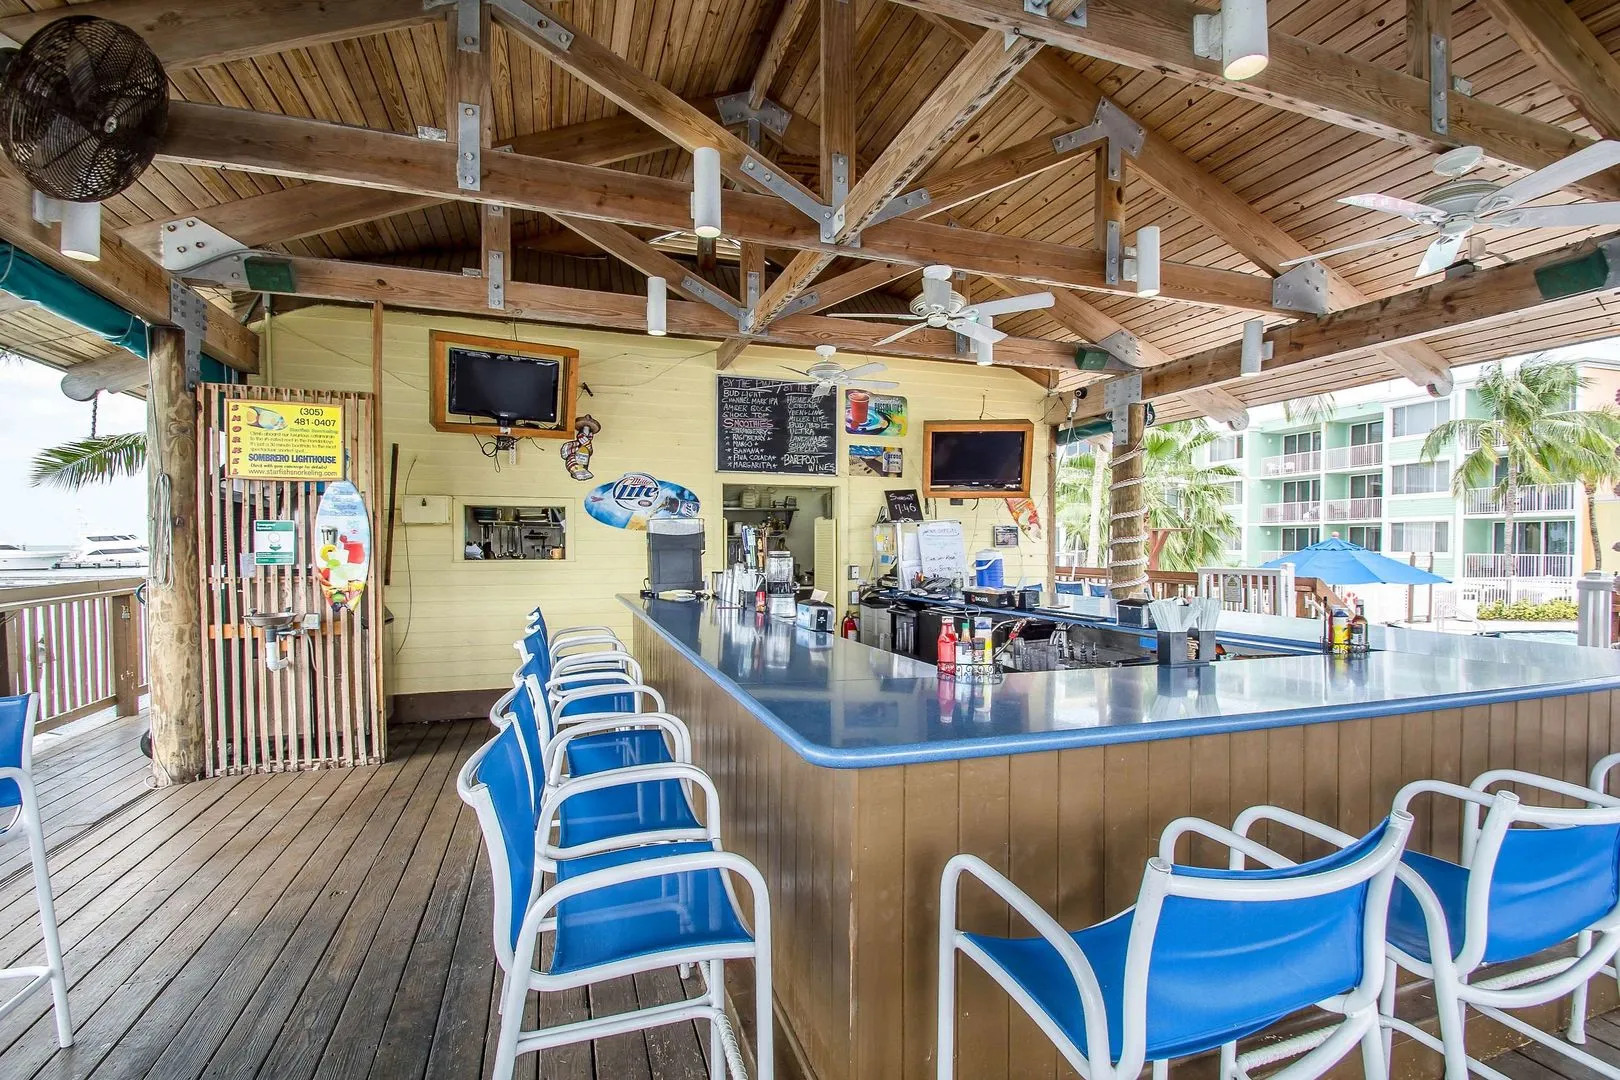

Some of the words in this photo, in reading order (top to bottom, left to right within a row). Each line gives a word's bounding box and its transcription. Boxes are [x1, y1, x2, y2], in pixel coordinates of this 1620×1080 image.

[722, 378, 734, 387] BY
[723, 389, 739, 397] BUD
[300, 408, 323, 416] (305)
[724, 403, 748, 412] AMBER
[294, 418, 336, 426] 481-0407
[723, 418, 773, 428] SMOOTHIES
[249, 454, 289, 462] SOMBRERO
[292, 455, 336, 464] LIGHTHOUSE
[784, 454, 825, 466] BAREFOOT
[808, 463, 835, 472] WINES
[249, 469, 337, 477] www.starfishsnorkeling.com
[616, 485, 660, 500] Lite
[894, 503, 916, 514] 7:46
